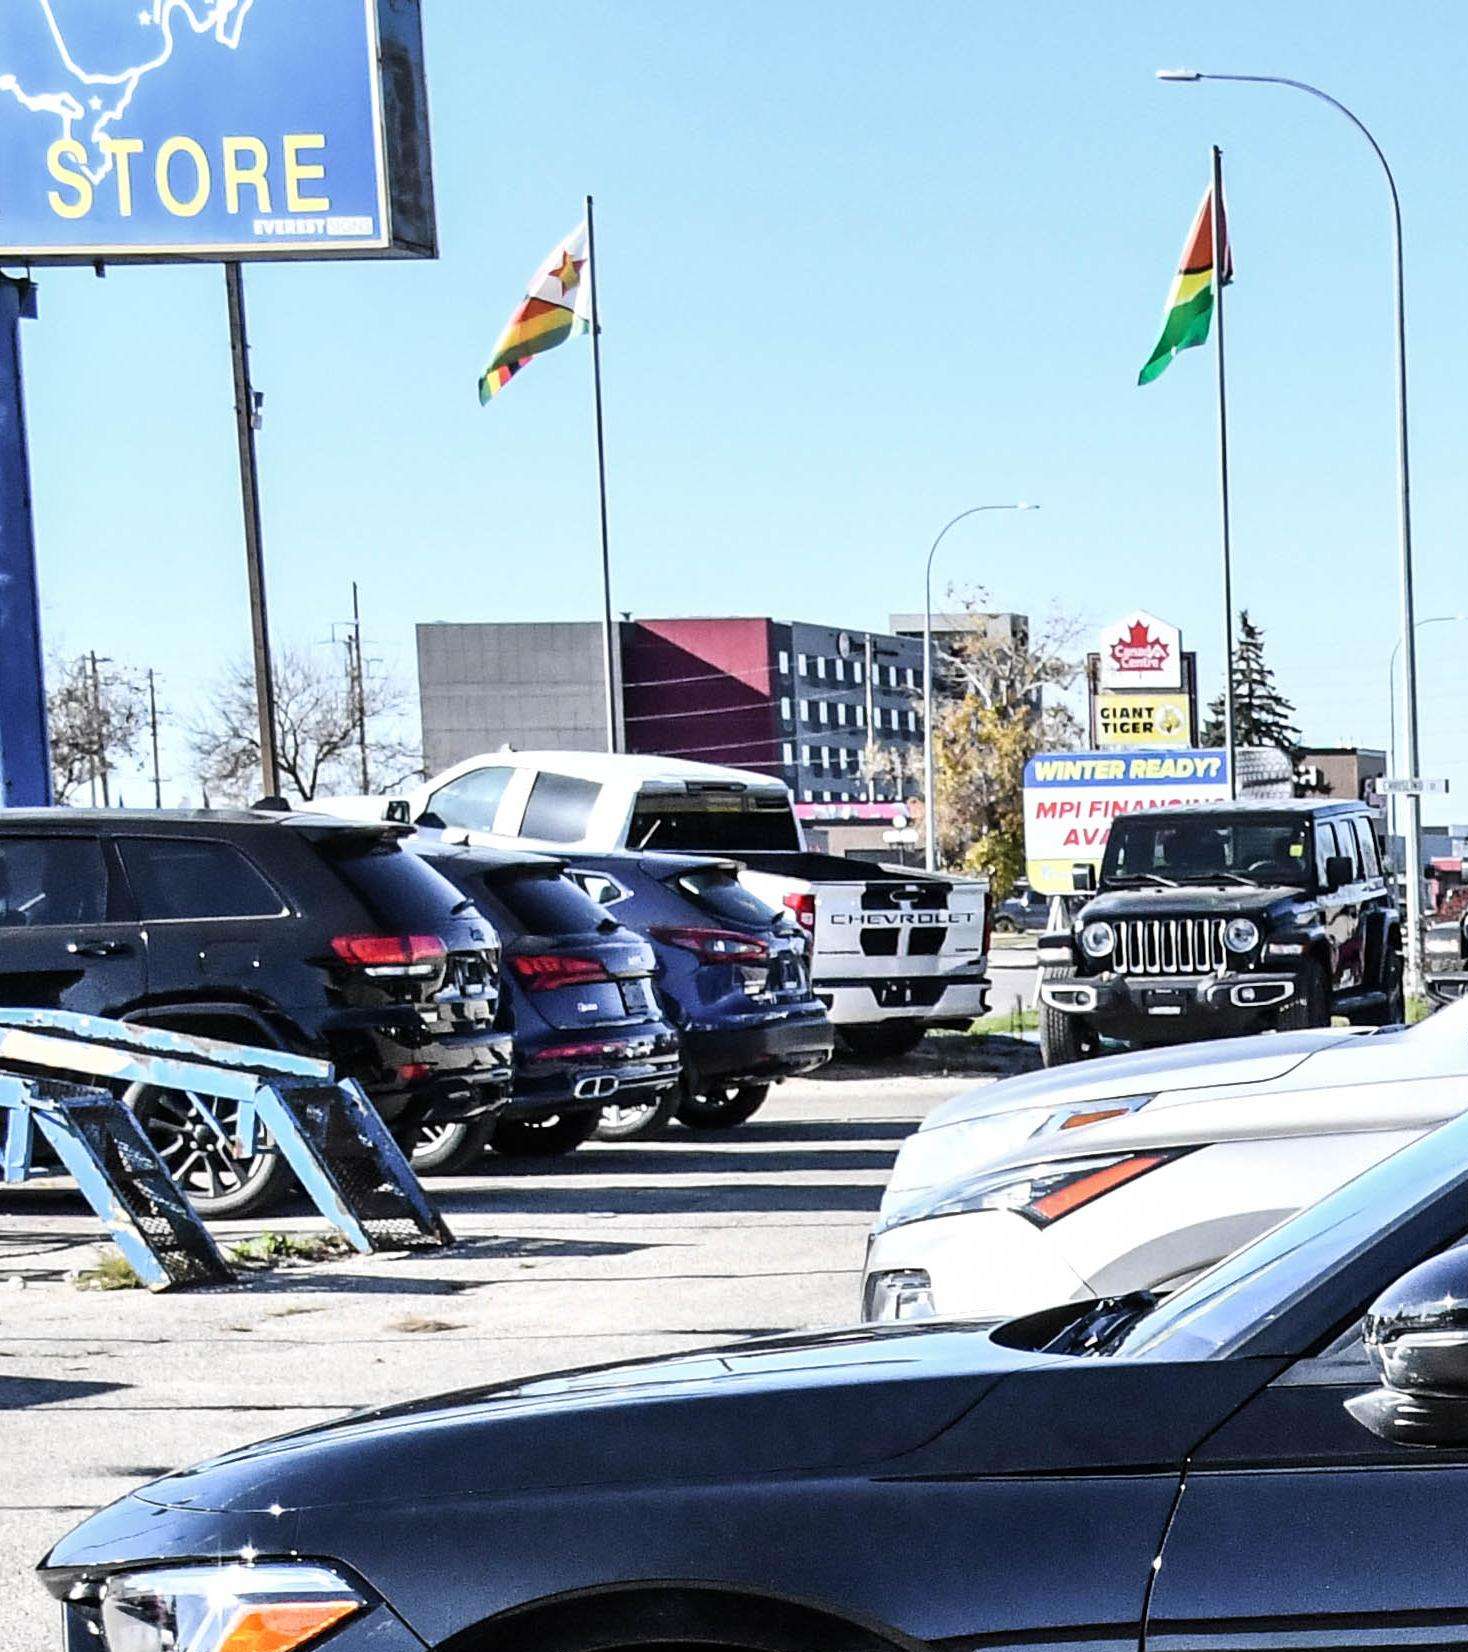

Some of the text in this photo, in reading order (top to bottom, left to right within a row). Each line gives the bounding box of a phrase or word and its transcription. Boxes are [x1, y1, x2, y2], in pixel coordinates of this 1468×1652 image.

[47, 134, 331, 219] STORE
[1100, 707, 1154, 719] GIANT
[1102, 722, 1154, 734] TIGER
[1034, 757, 1221, 781] WINTER READY?
[1036, 801, 1081, 819] MPI
[831, 912, 974, 925] CHEVROLET
